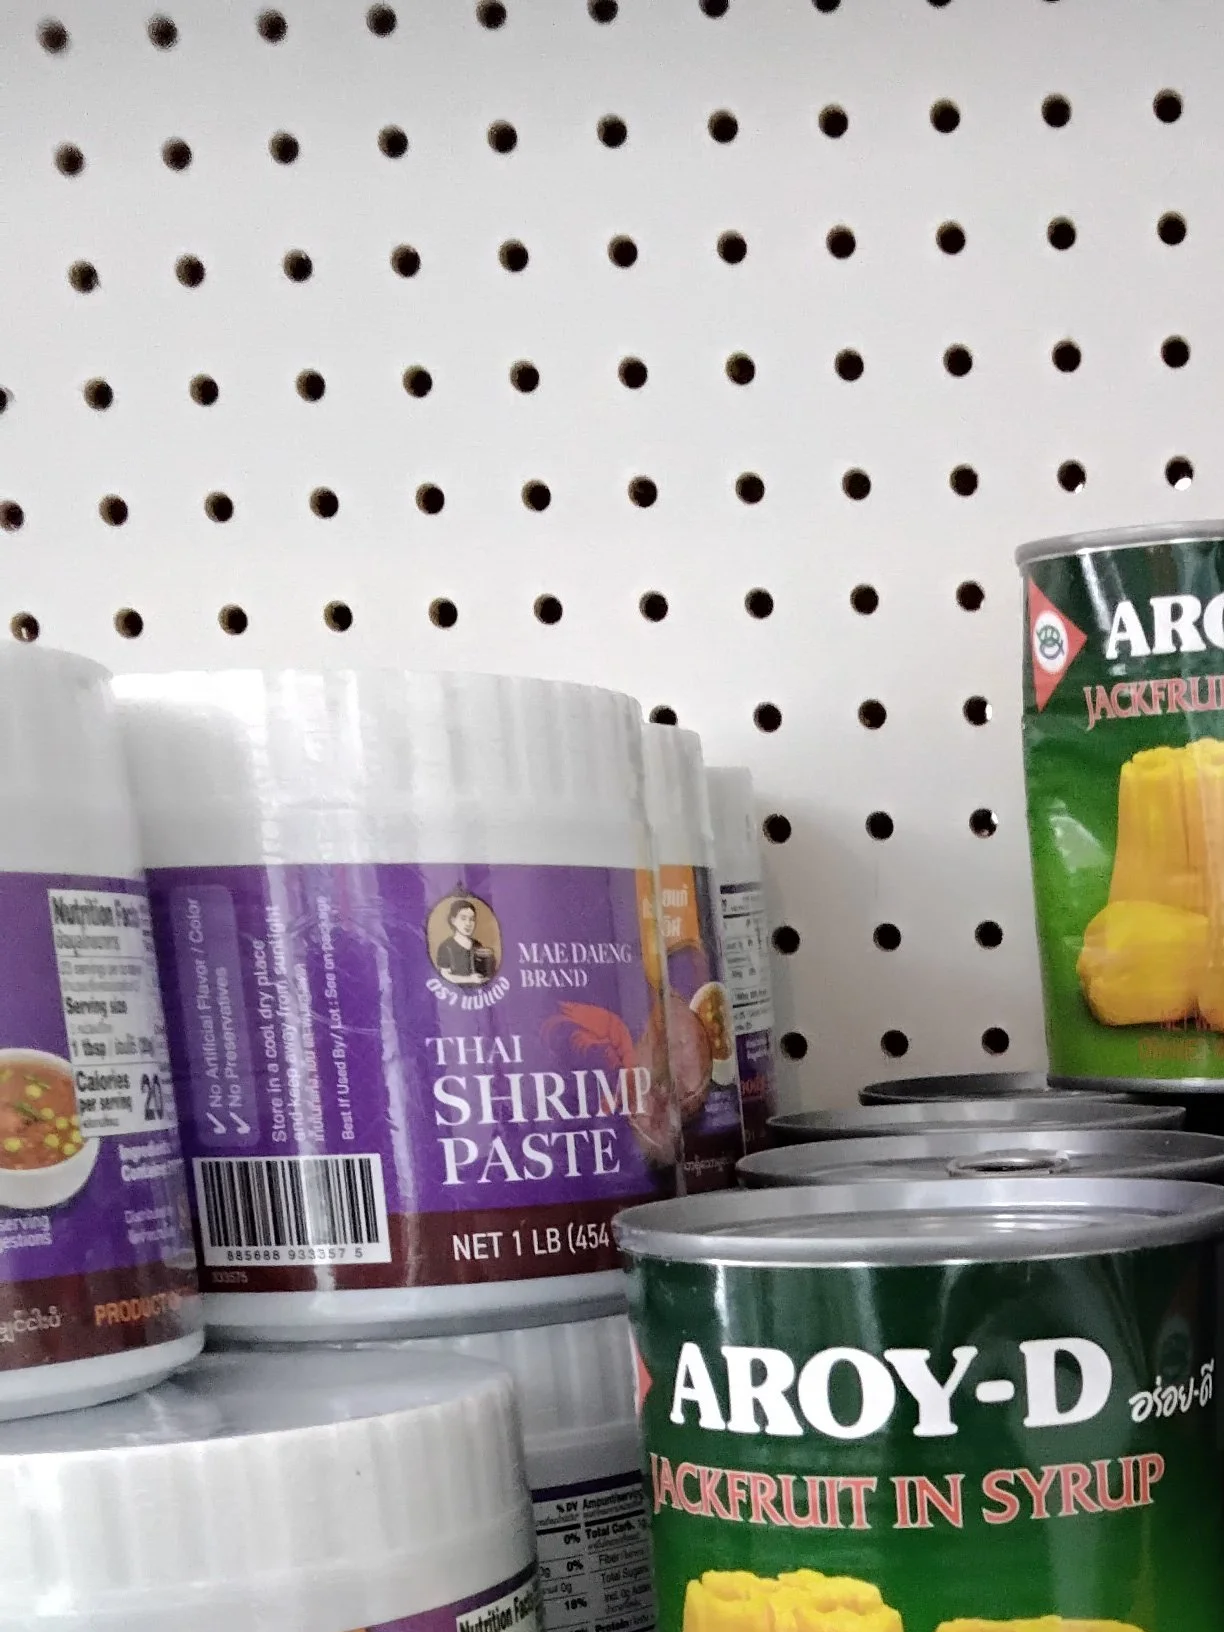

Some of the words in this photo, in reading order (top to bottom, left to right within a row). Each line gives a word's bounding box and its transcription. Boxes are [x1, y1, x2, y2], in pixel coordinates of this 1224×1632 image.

[518, 942, 570, 965] MAE
[571, 941, 632, 964] DAENG
[520, 968, 588, 989] BRAND
[426, 1034, 524, 1066] THAI
[433, 1066, 651, 1126] SHRIMP
[437, 1128, 620, 1186] PASTE
[452, 1231, 503, 1261] NET
[512, 1231, 522, 1257] 1
[532, 1227, 562, 1256] LB
[567, 1222, 611, 1254] (454
[670, 1337, 1113, 1439] AROY-D
[650, 1453, 876, 1530] JACKFRUIT
[890, 1473, 965, 1530] IN
[983, 1453, 1166, 1525] SYRUP
